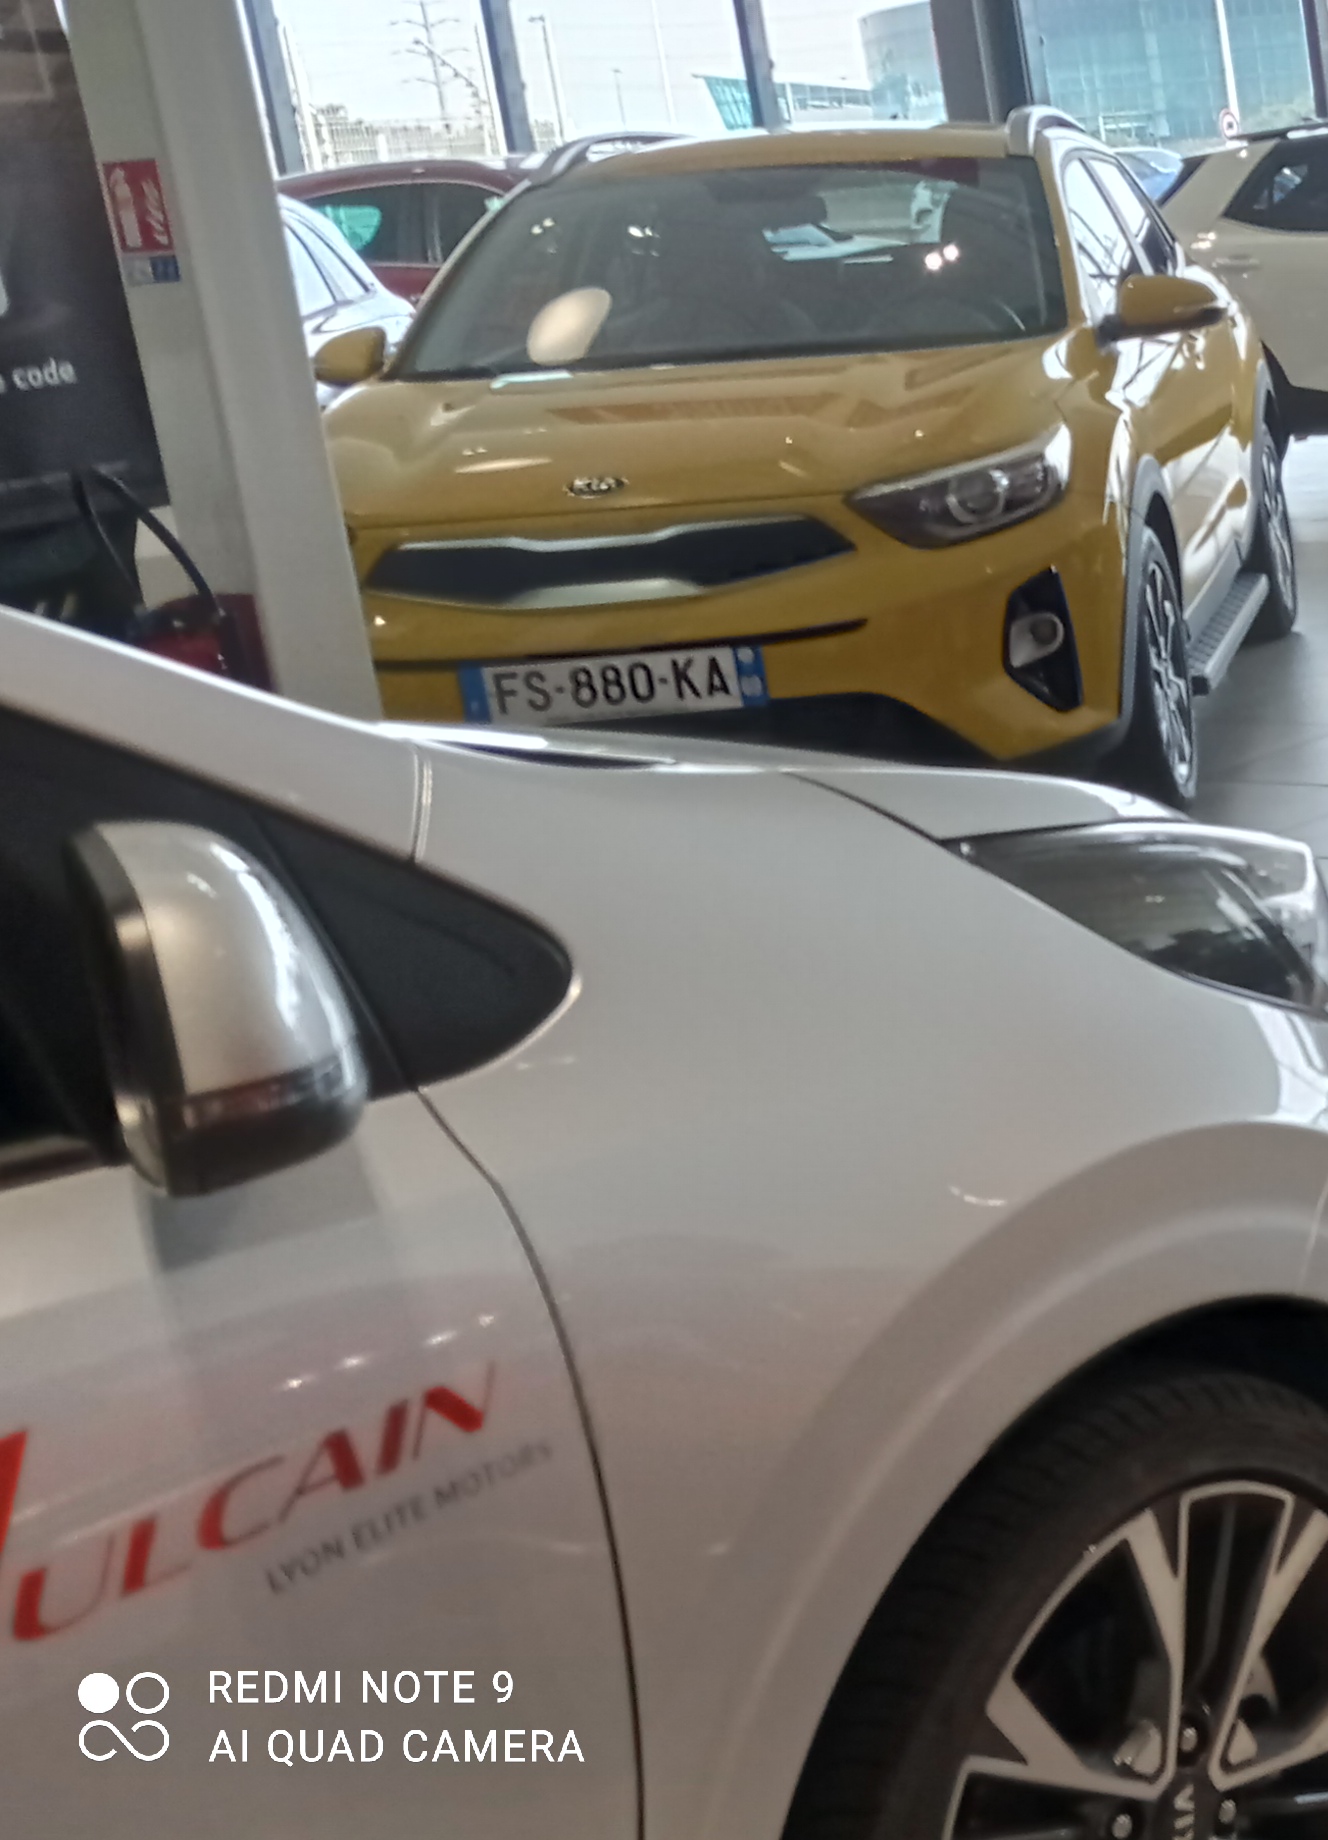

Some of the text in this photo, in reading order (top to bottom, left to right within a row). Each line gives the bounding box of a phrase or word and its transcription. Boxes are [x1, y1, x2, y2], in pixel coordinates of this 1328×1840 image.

[12, 356, 78, 392] code
[493, 654, 732, 715] FS-880-KA
[265, 1441, 553, 1595] LYON ELITE MOTORS
